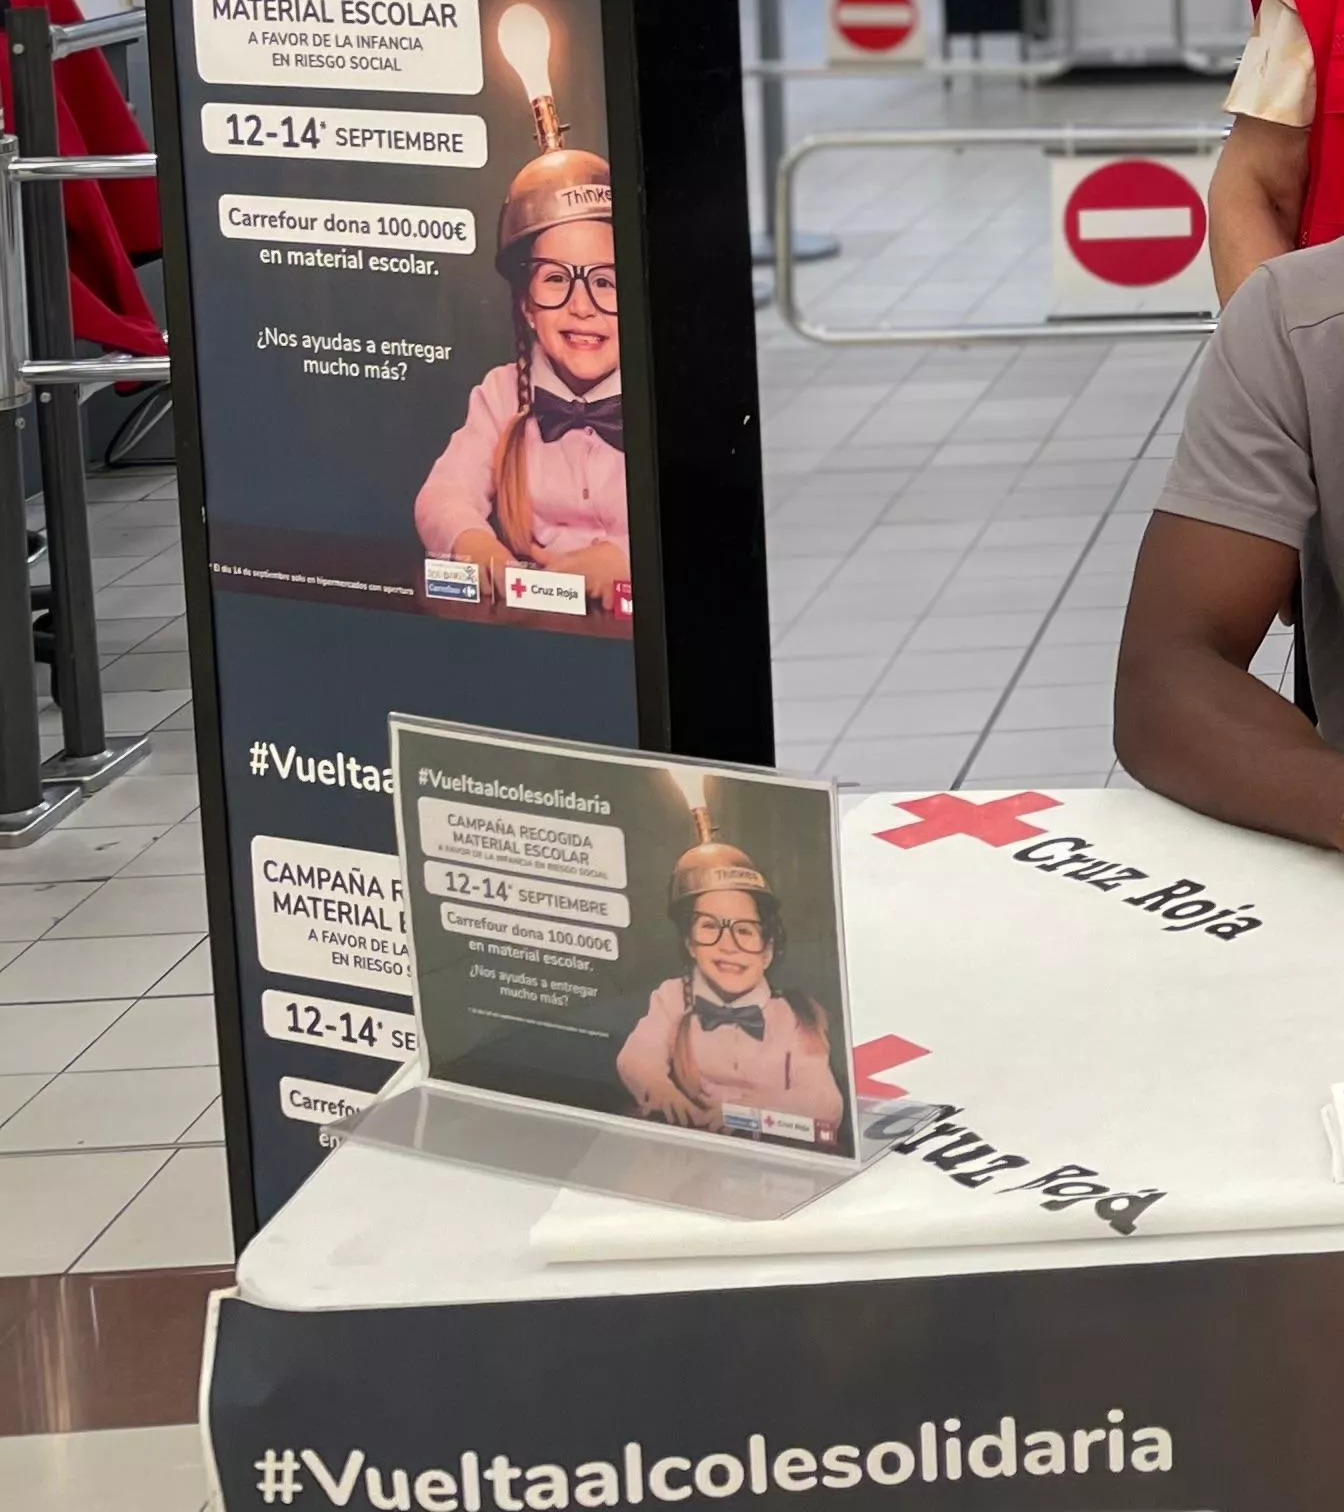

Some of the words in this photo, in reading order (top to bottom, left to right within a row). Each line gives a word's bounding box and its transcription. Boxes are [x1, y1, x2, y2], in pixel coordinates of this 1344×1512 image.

[341, 1, 458, 28] ESCOLAR
[248, 31, 258, 45] A
[262, 32, 308, 47] FAVOR
[312, 33, 332, 48] DE
[335, 34, 353, 49] LA
[356, 35, 424, 51] INFANCIA
[272, 53, 290, 67] EN
[295, 53, 346, 70] RIESGO
[350, 56, 402, 72] SOCIAL
[335, 127, 464, 153] SEPTIEMBRE
[228, 207, 319, 233] Carrefour
[324, 213, 371, 235] dona
[377, 217, 467, 242] 100.000€
[260, 250, 282, 265] en
[287, 246, 363, 270] material
[369, 253, 439, 276] escolar.
[257, 327, 298, 349] ¿Nos
[302, 333, 361, 356] ayudas
[366, 341, 376, 352] a
[381, 340, 452, 364] entregar
[303, 357, 360, 377] mucho
[364, 360, 408, 381] más?
[531, 584, 554, 597] Cruz
[556, 587, 579, 600] Roja
[418, 767, 611, 816] #Vueltaalcolesolidaria
[447, 813, 516, 837] CAMPAÑA
[519, 825, 593, 849] RECOGIDA
[453, 831, 520, 855] MATERIAL
[524, 842, 589, 866] ESCOLAR
[263, 859, 385, 901] CAMPAÑA
[1013, 836, 1150, 892] Cruz
[1123, 879, 1264, 941] Roja
[272, 890, 392, 932] MATERIAL
[518, 889, 608, 917] SEPTIEMBRE
[308, 929, 319, 943] A
[322, 929, 368, 949] FAVOR
[370, 938, 394, 954] DE
[447, 911, 508, 933] Carrefour
[512, 924, 544, 941] dona
[548, 929, 612, 953] 100.000€
[332, 951, 350, 966] EN
[353, 955, 403, 977] RIESGO
[468, 940, 484, 952] en
[488, 942, 540, 963] material
[543, 953, 594, 972] escolar.
[469, 964, 496, 979] ¿Nos
[498, 970, 538, 988] ayudas
[541, 979, 547, 988] a
[550, 980, 598, 999] entregar
[499, 985, 537, 1002] mucho
[540, 993, 569, 1007] más?
[253, 1408, 1174, 1512] #Vueltaalcolesolidaria
